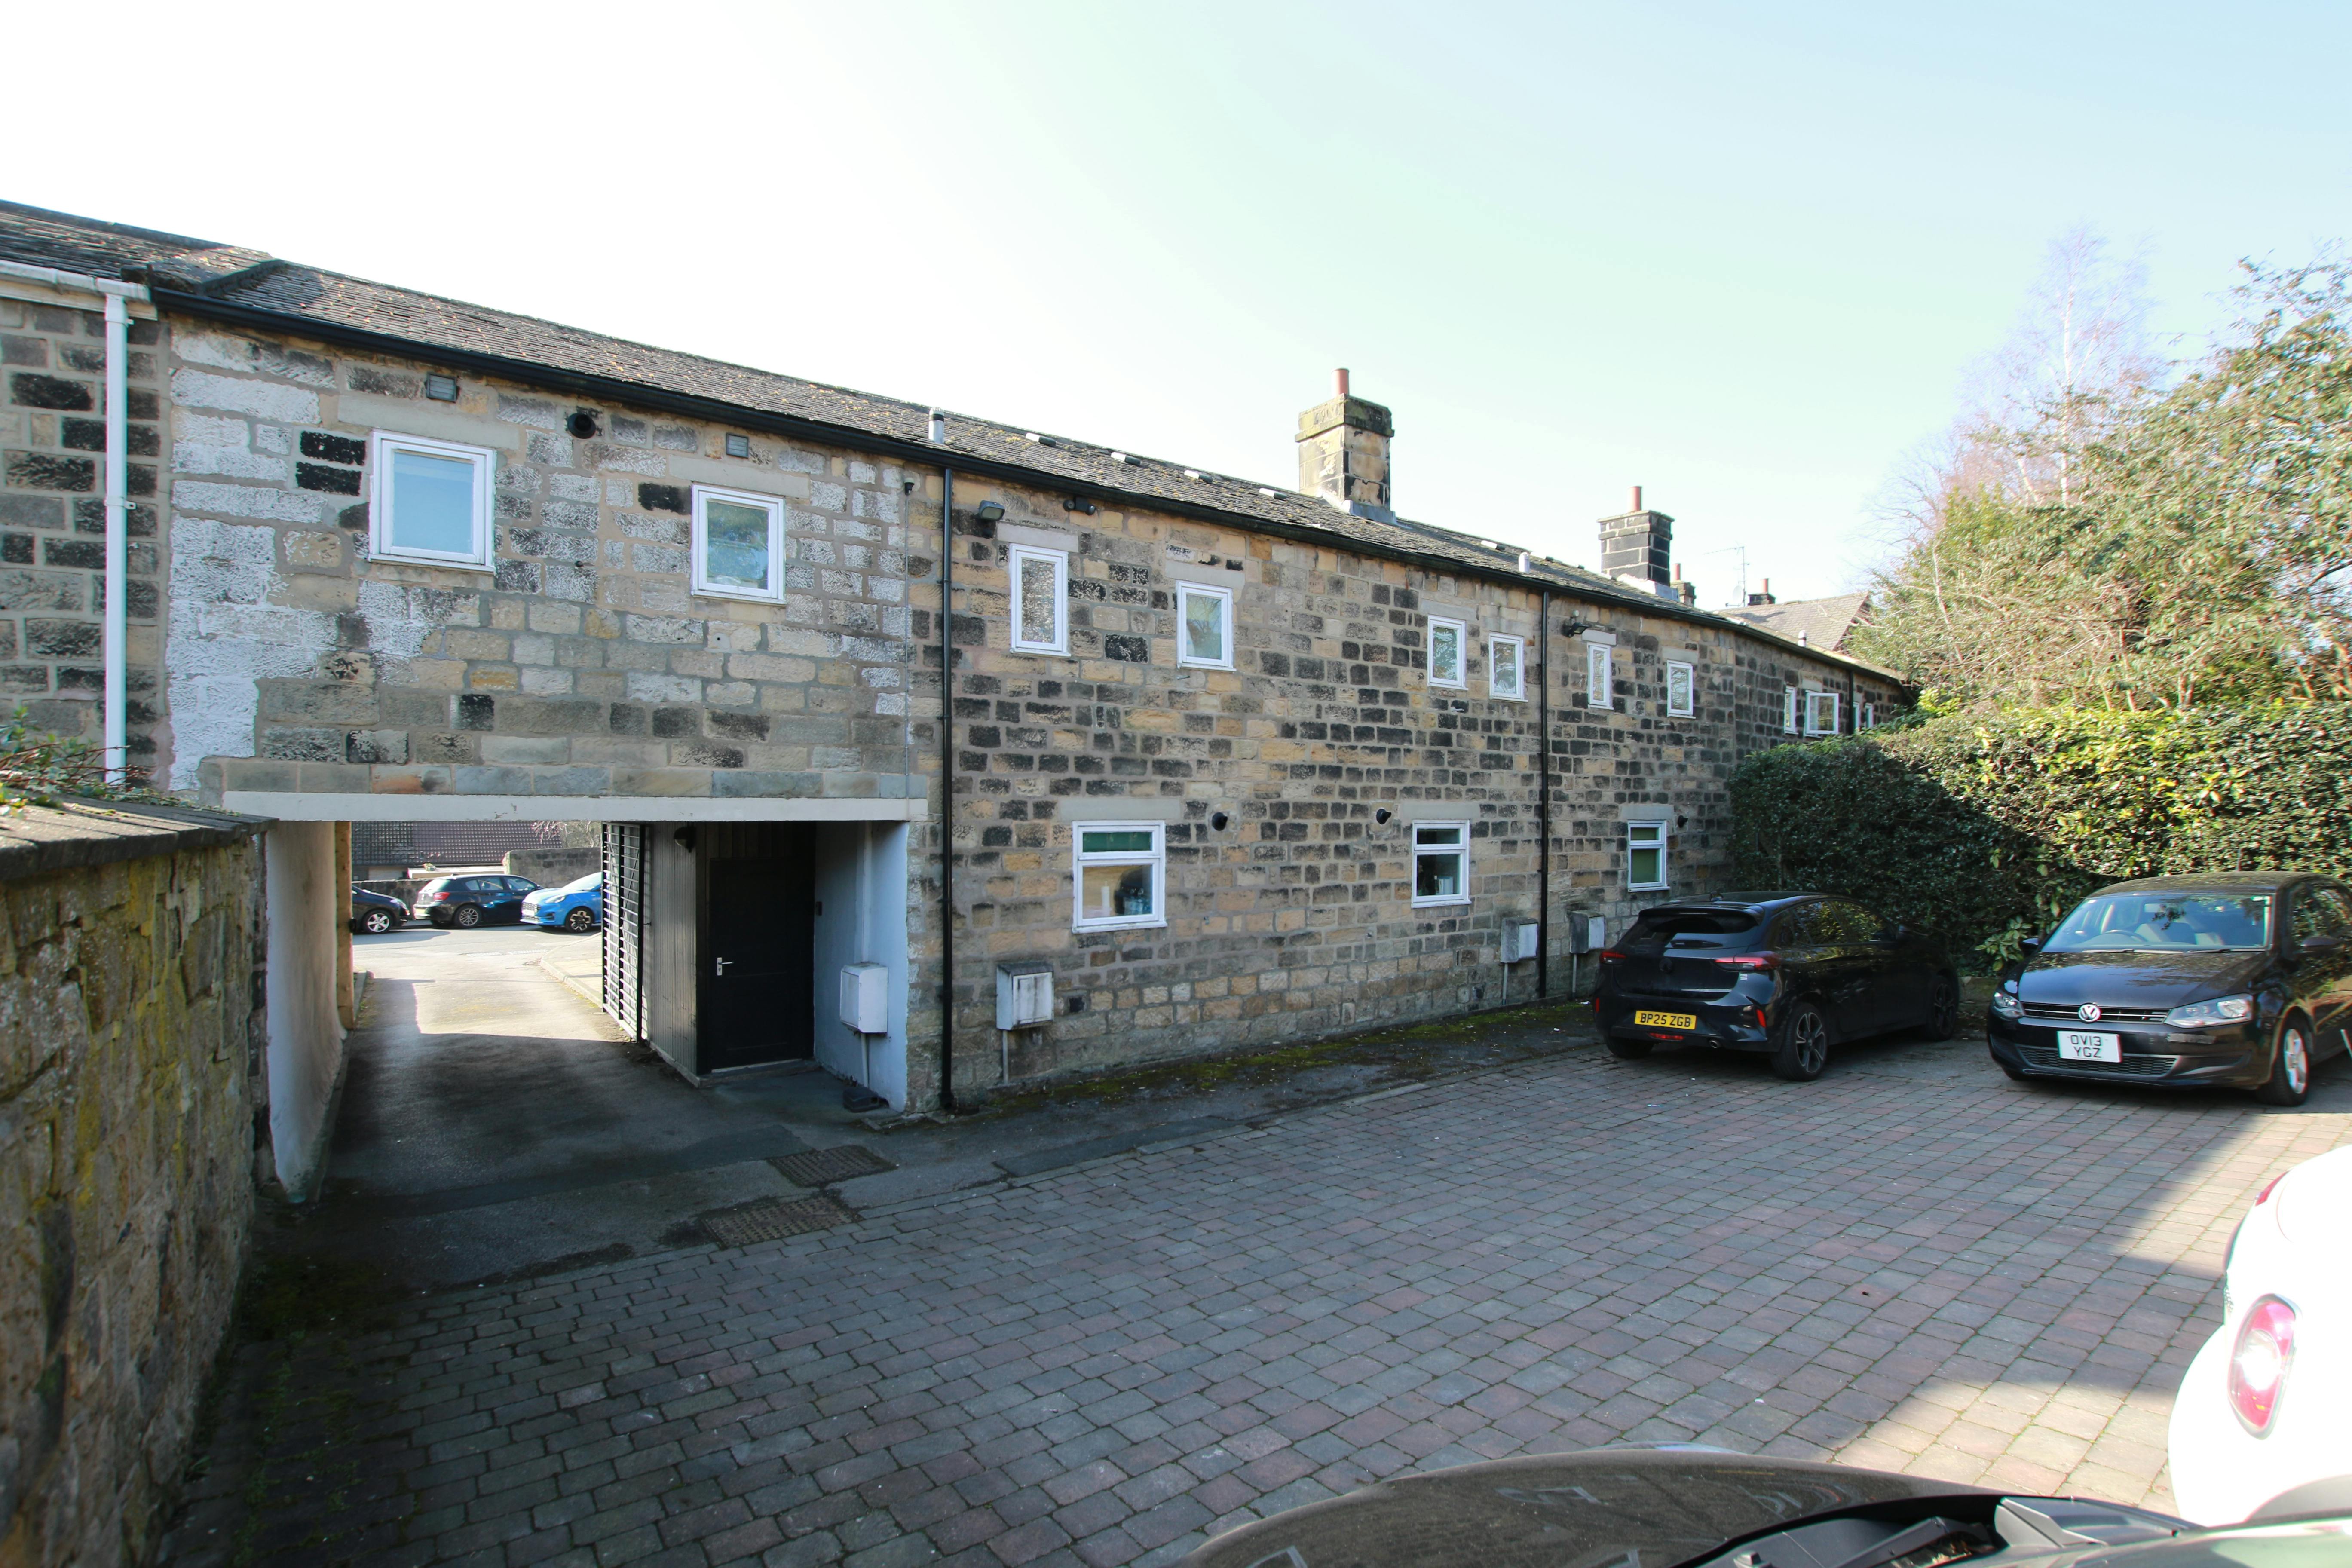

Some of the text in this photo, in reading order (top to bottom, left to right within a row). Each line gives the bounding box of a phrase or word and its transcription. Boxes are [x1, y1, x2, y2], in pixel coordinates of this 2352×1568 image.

[1640, 1013, 1691, 1027] BP25 ZGB
[2070, 1035, 2101, 1046] OV13
[2073, 1047, 2101, 1058] YGZ
